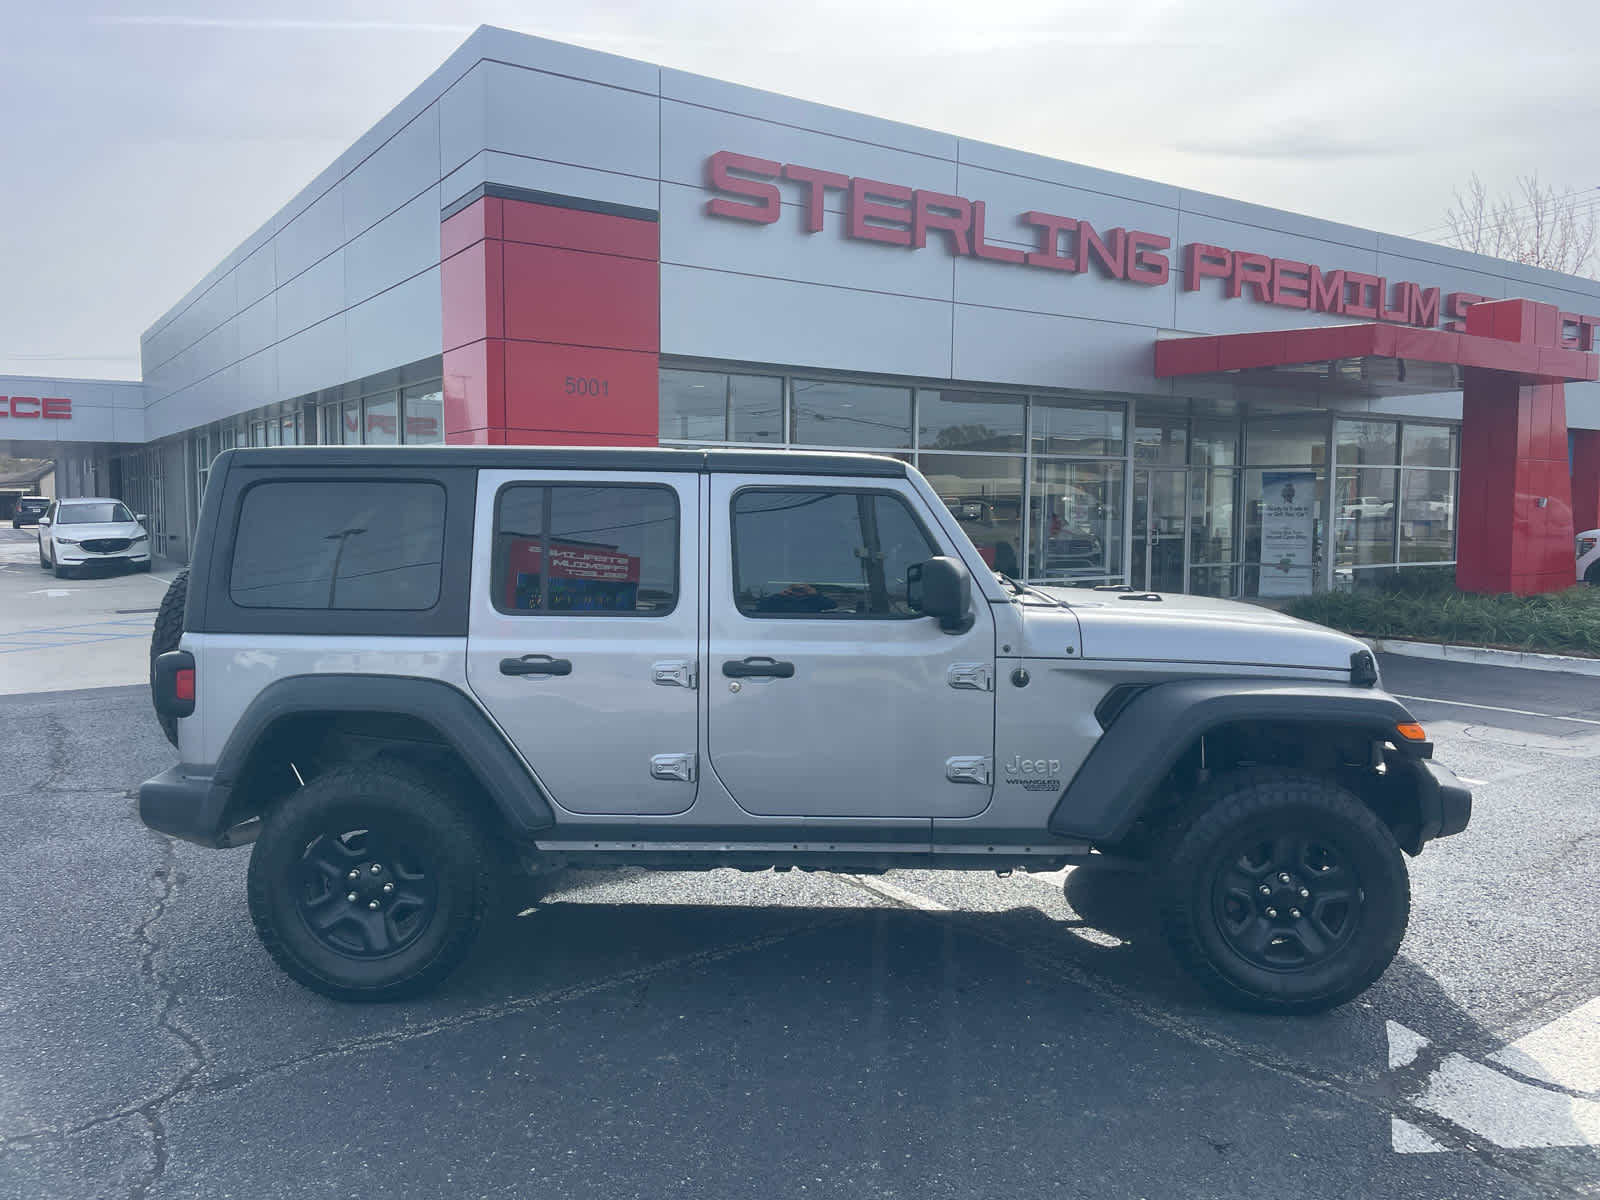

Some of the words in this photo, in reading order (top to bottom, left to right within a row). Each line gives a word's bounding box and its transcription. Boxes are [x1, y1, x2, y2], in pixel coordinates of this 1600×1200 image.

[707, 150, 1171, 287] STERLING
[1184, 242, 1441, 328] PREMIUM
[1446, 292, 1600, 353] SCT
[564, 376, 608, 397] 5001
[1005, 755, 1060, 777] Jeep
